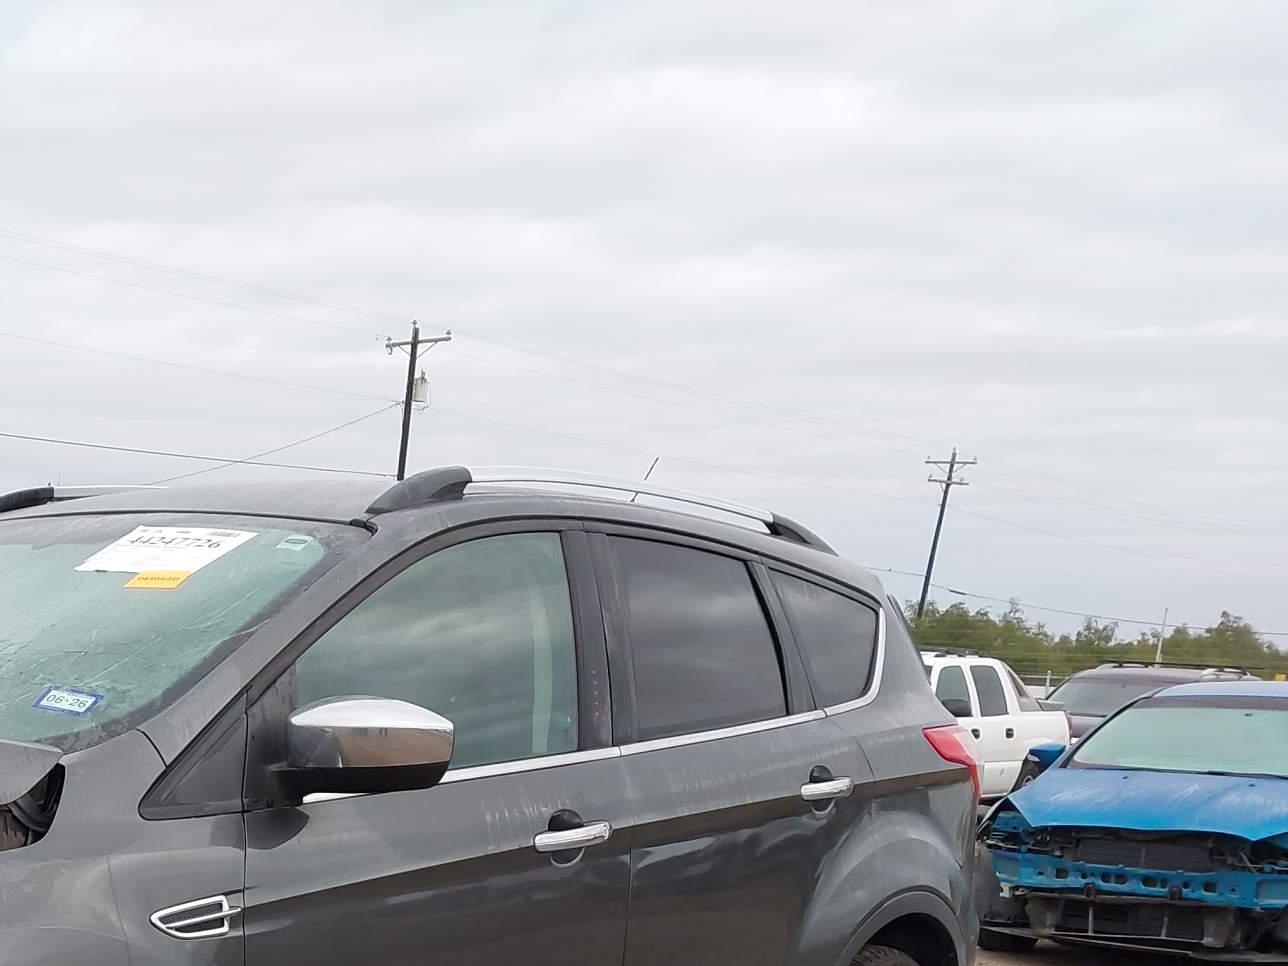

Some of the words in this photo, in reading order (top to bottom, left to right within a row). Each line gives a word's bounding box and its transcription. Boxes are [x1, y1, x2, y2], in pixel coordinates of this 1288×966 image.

[130, 535, 222, 550] 44247726
[46, 694, 65, 704] 06
[68, 698, 88, 709] 26
